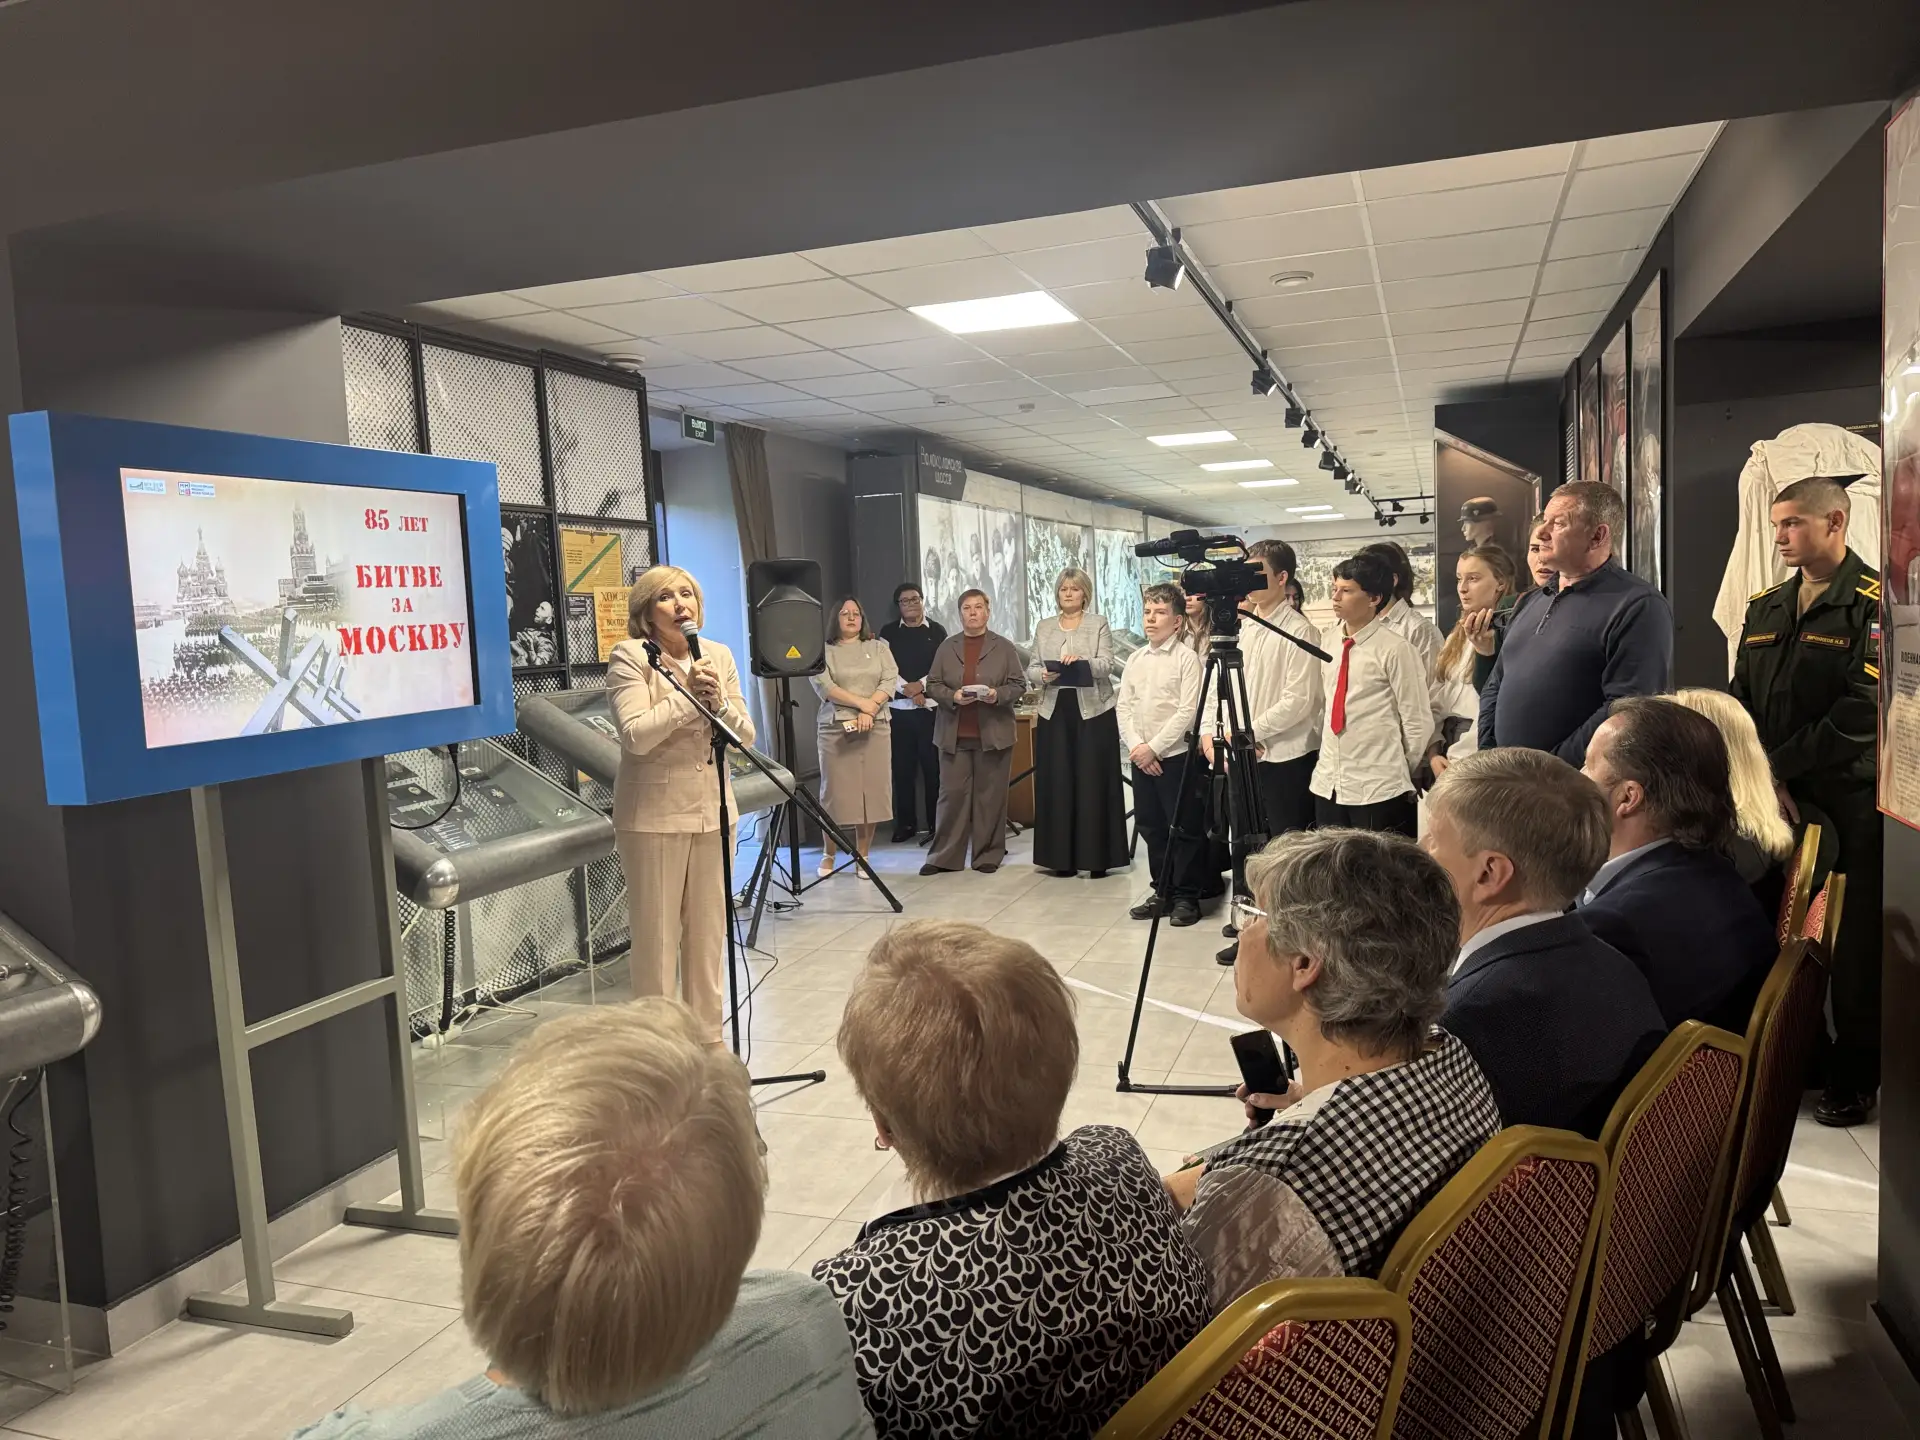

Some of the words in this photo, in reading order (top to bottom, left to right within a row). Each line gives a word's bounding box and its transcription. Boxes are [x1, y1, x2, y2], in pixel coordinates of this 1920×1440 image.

[364, 508, 390, 531] 85
[398, 515, 429, 533] ЛЕТ
[355, 564, 443, 588] БИТВЕ
[391, 597, 414, 613] ЗА
[337, 622, 466, 657] МОСКВУ
